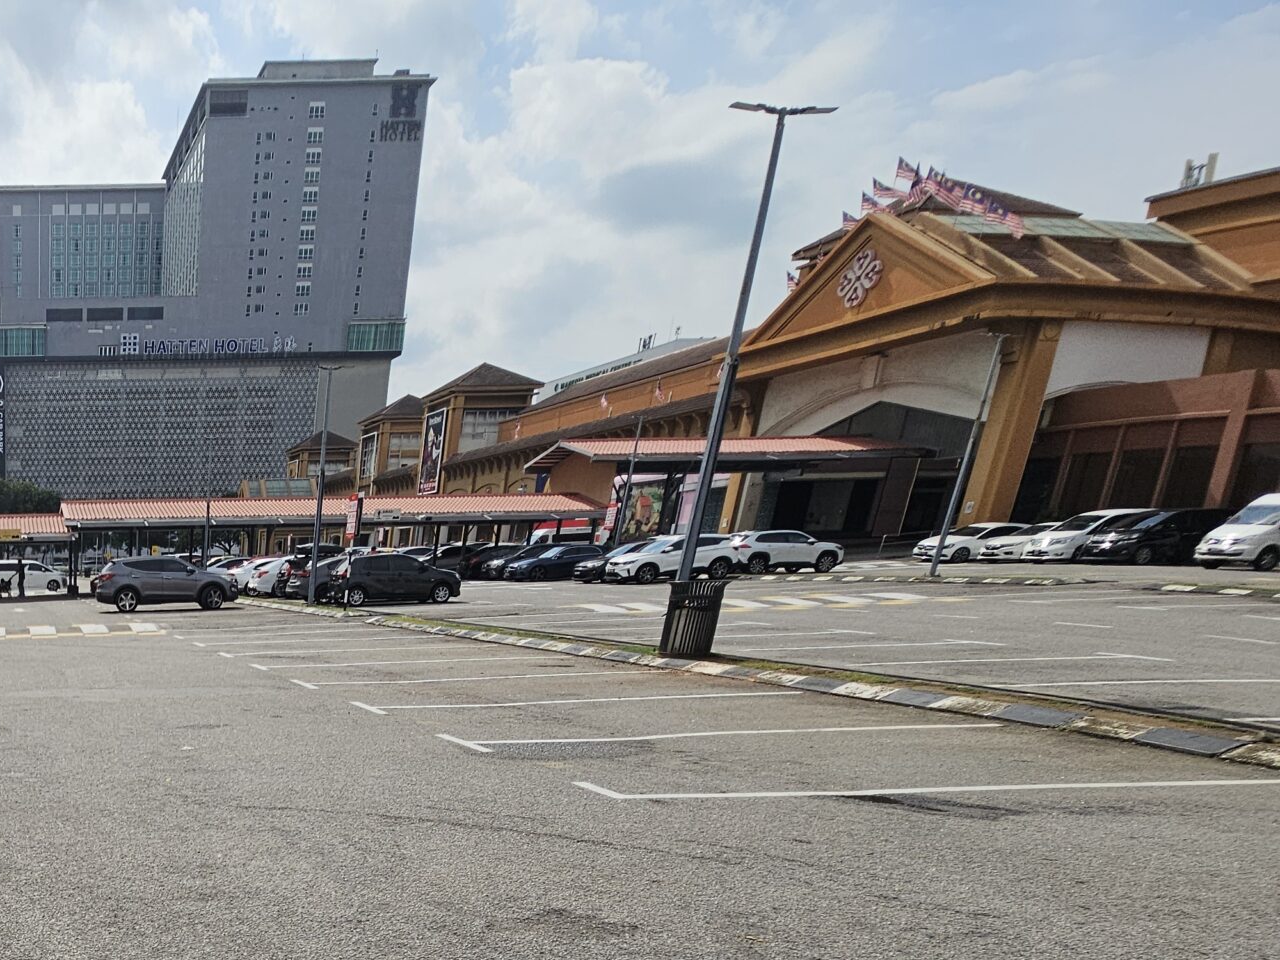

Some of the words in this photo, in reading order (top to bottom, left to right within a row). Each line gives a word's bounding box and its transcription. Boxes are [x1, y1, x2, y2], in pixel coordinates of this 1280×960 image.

[379, 129, 420, 142] HOTEL
[143, 338, 209, 354] HATTEN
[214, 337, 268, 354] HOTEL
